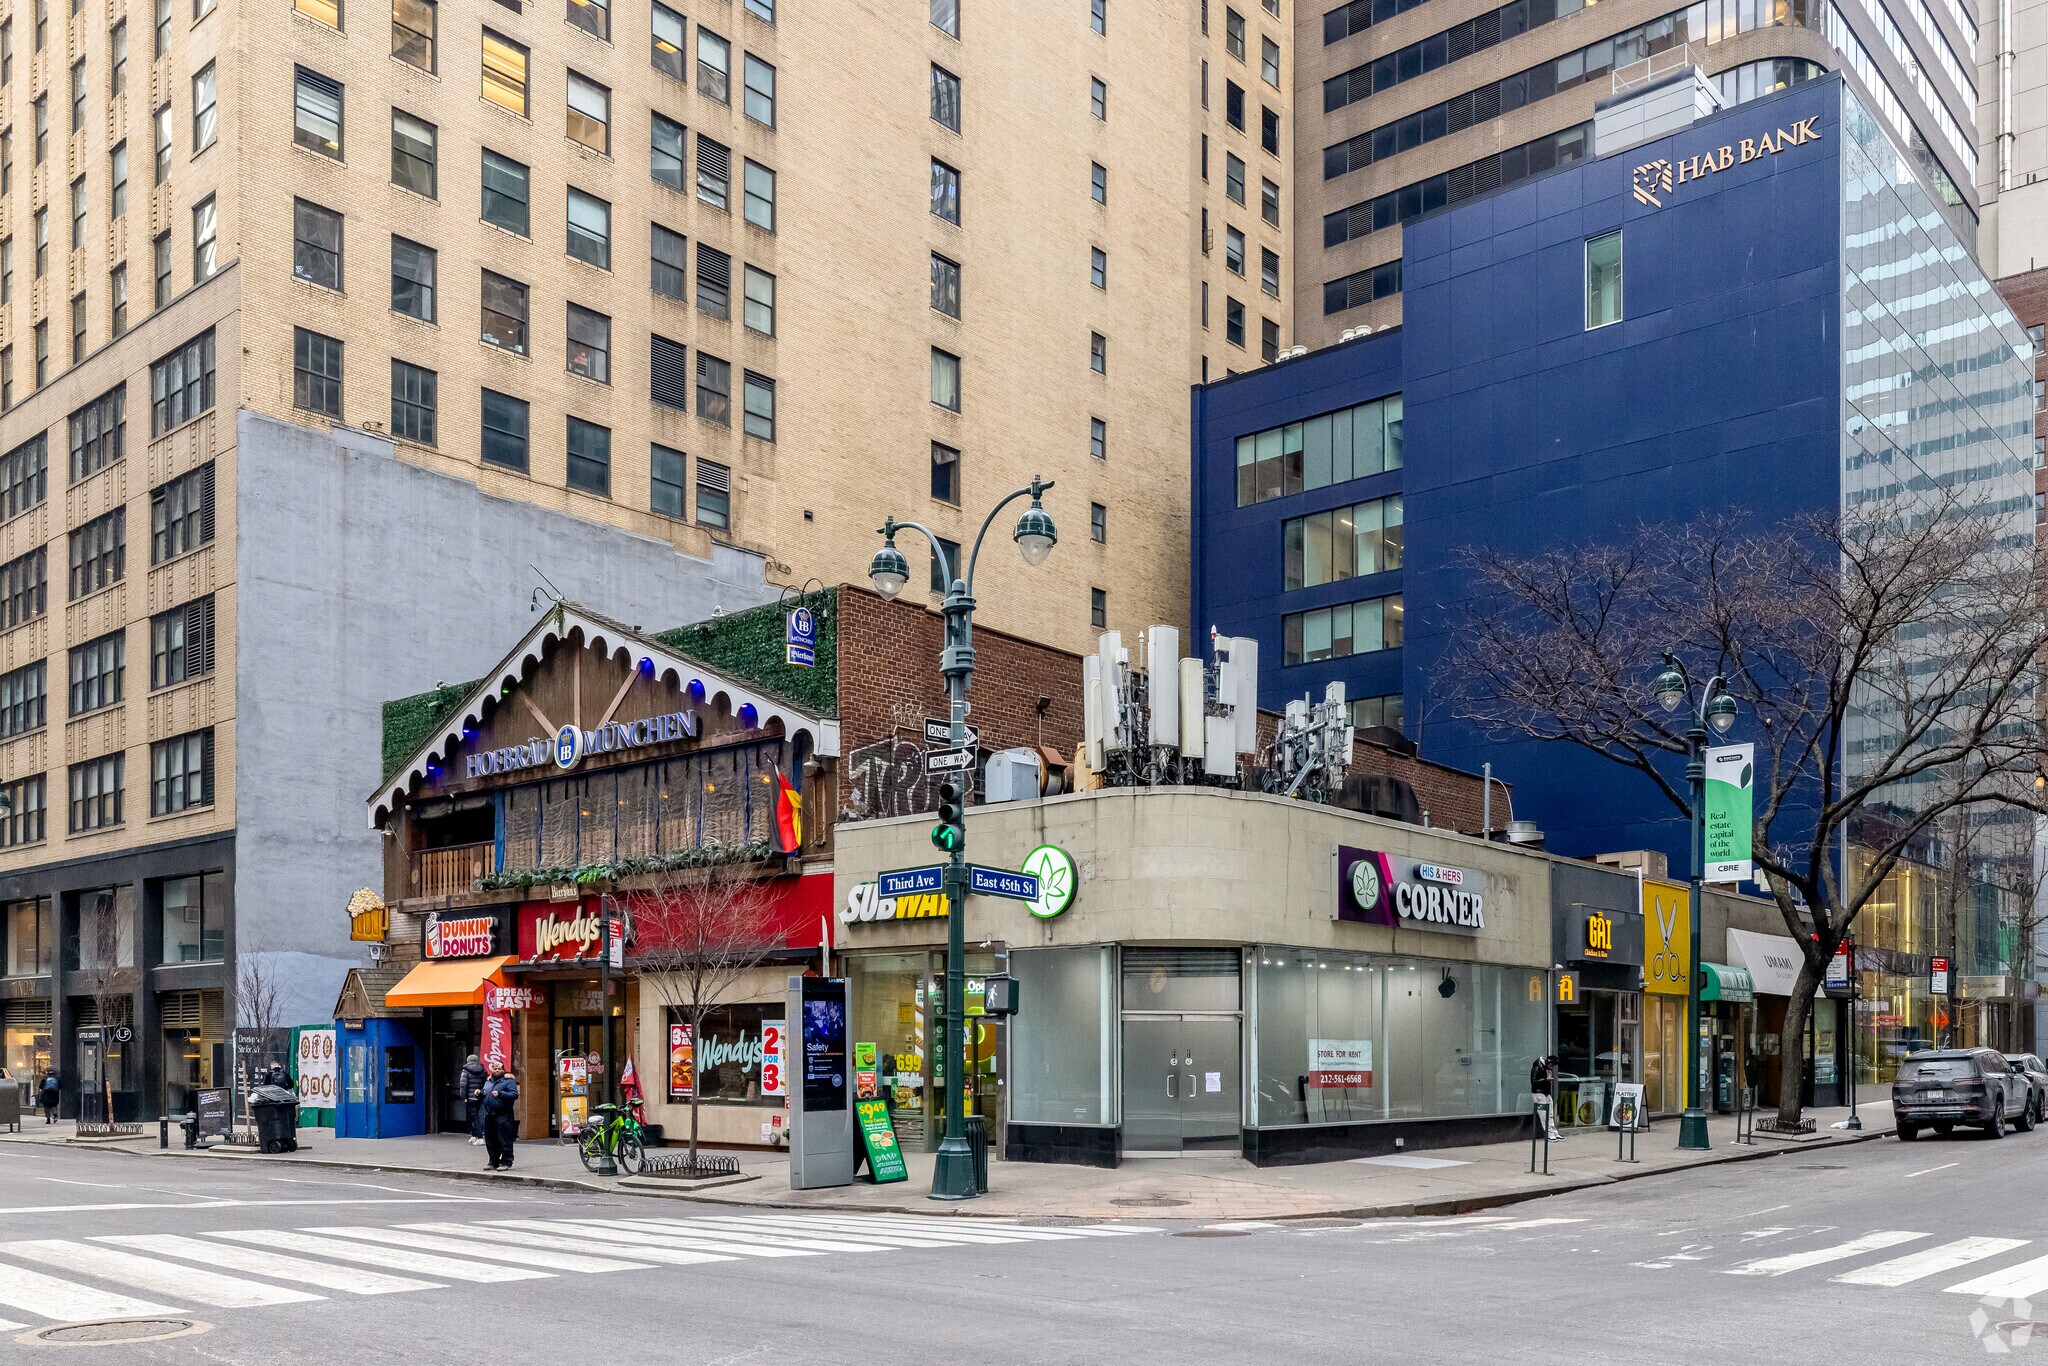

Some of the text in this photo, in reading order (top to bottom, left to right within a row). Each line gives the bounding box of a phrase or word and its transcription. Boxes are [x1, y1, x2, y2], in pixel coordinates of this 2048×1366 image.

[1677, 115, 1822, 184] HAB BANK
[799, 620, 809, 632] HB
[930, 726, 947, 737] ONE
[466, 709, 695, 779] HOFBRÄU HB MÜNCHEN
[933, 754, 969, 767] ONE WAY
[1710, 812, 1726, 820] Real
[1710, 822, 1731, 830] estate
[1710, 830, 1734, 841] capital
[1710, 840, 1730, 848] of the
[1710, 849, 1731, 858] world
[1422, 866, 1461, 883] HIS & HERS
[1718, 864, 1739, 872] CBRE
[887, 874, 935, 891] Third Ave
[975, 874, 1034, 894] East 45th St
[551, 884, 578, 899] Bierhaus
[1396, 881, 1485, 928] CORNER
[443, 919, 492, 938] DUNKIN'
[536, 905, 600, 955] Wendy's
[443, 937, 489, 955] DONUTS
[1763, 954, 1794, 970] UMAMI
[496, 988, 532, 997] BREAK
[496, 997, 532, 1008] FAST
[764, 1027, 778, 1054] 2
[807, 1043, 829, 1052] Safety
[698, 1029, 762, 1073] Wendy's
[1317, 1050, 1333, 1058] STORE
[1336, 1050, 1346, 1058] FOR
[764, 1055, 778, 1063] FOR
[894, 1053, 922, 1071] $6.99
[763, 1064, 779, 1091] $3
